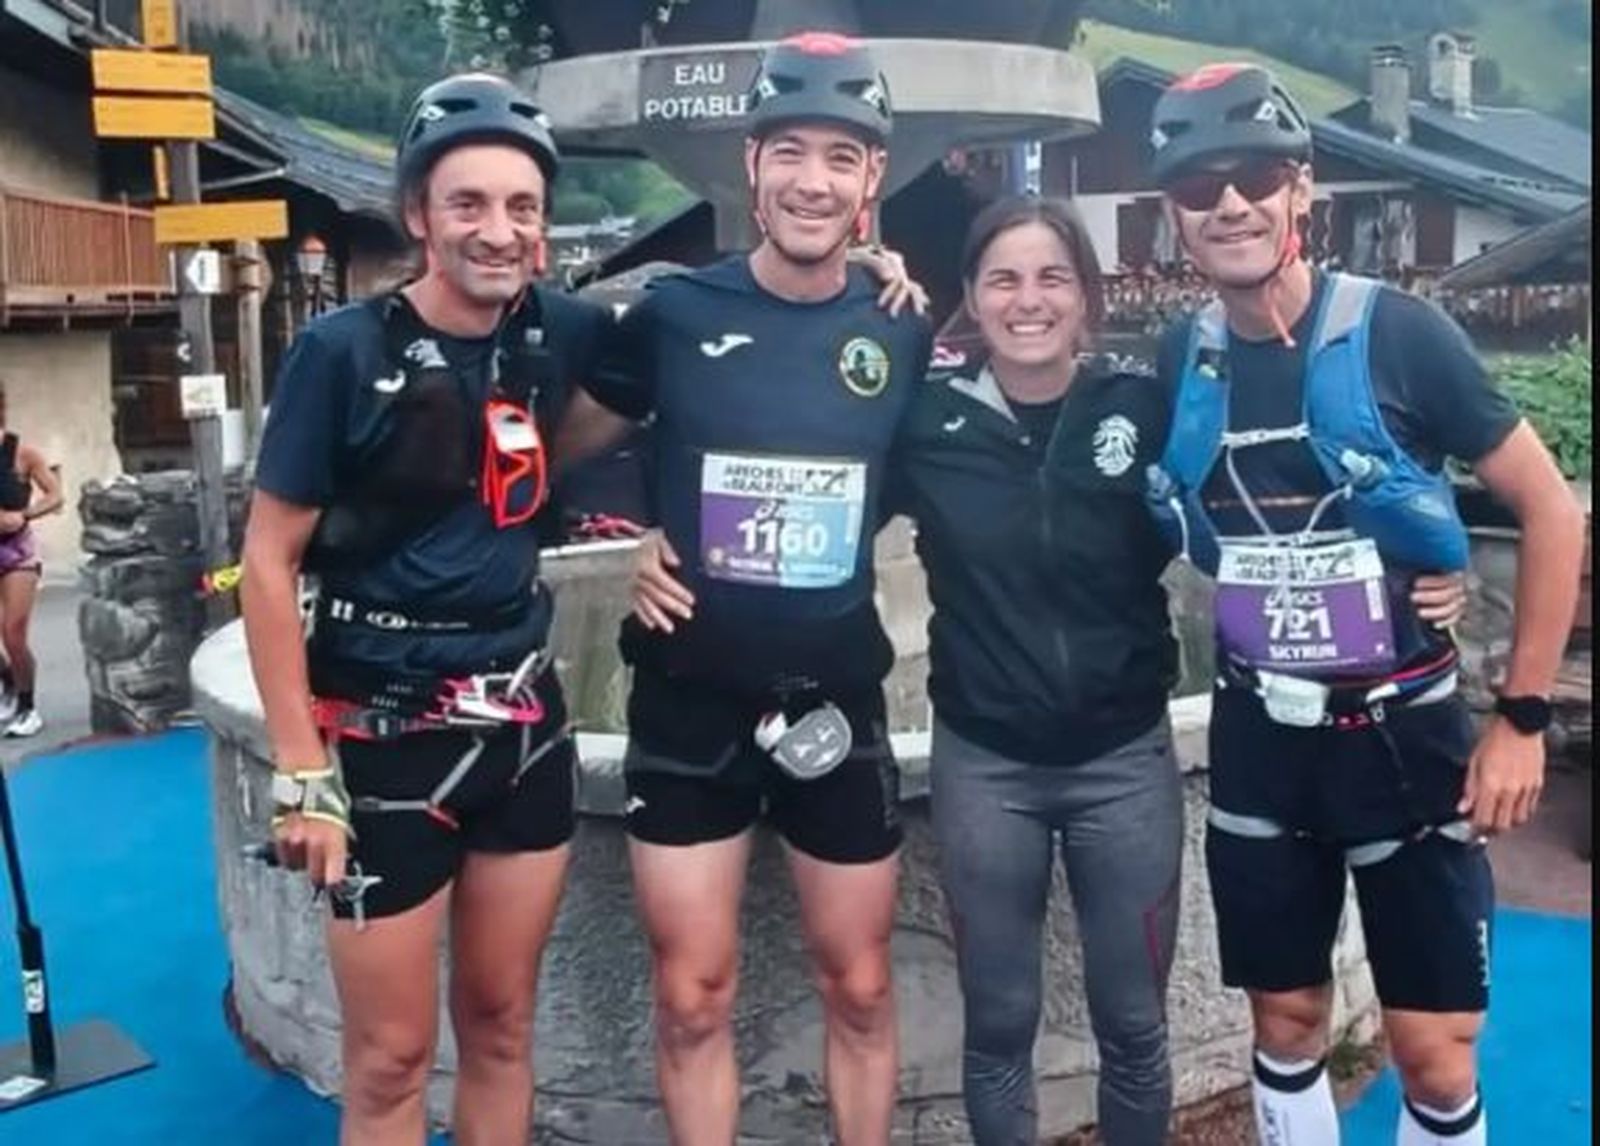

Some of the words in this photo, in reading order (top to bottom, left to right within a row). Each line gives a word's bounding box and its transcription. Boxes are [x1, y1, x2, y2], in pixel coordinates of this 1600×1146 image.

[675, 62, 725, 85] EAU
[738, 517, 829, 556] 1160
[1264, 607, 1332, 639] 721
[1269, 644, 1338, 660] SKYRUN
